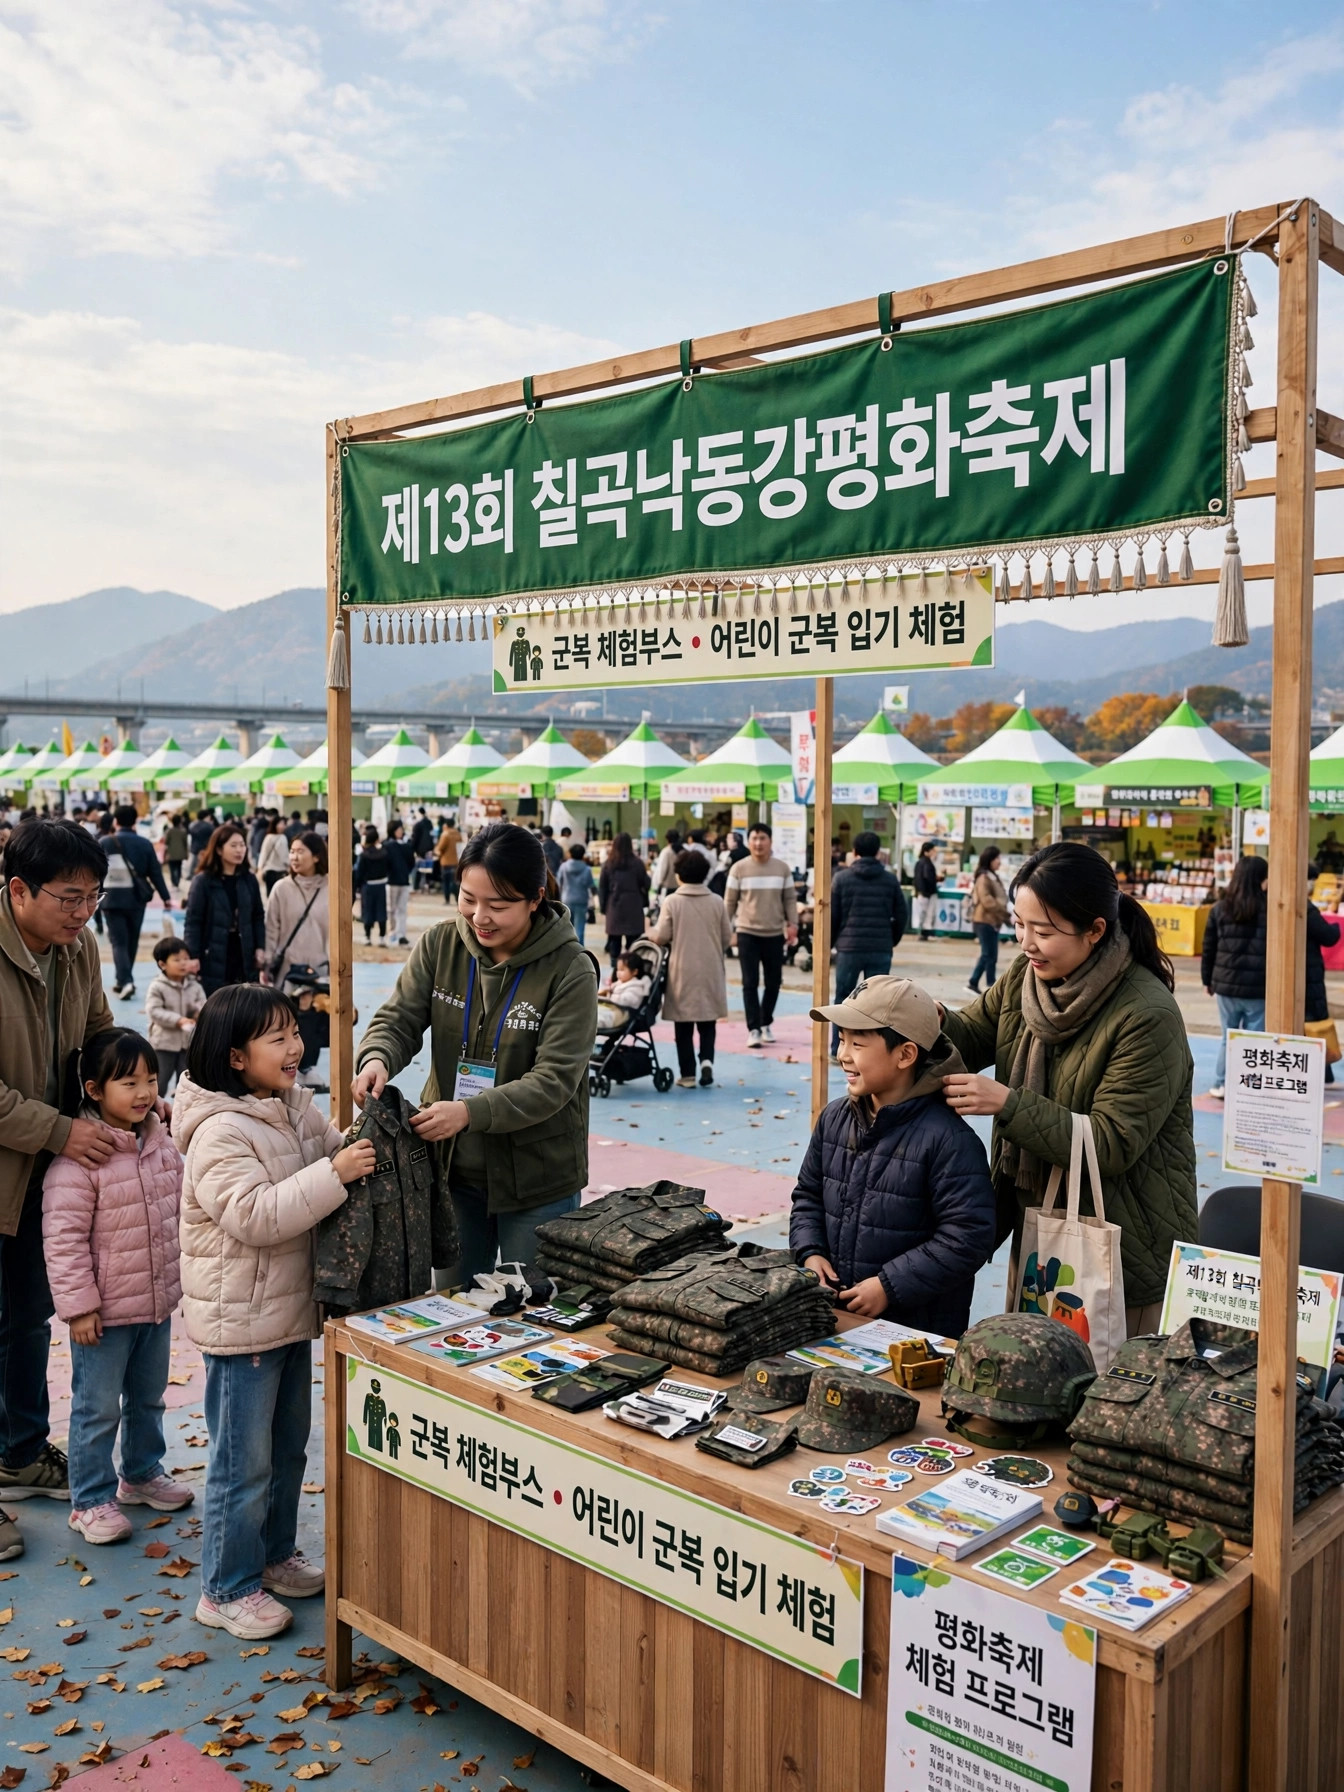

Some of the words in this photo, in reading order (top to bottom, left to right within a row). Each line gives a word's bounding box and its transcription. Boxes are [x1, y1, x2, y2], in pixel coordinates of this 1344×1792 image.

[380, 468, 515, 565] 제13회
[530, 357, 1127, 549] 칠곡낙동강평화축제
[551, 632, 592, 671] 군복
[596, 623, 683, 669] 체험부스
[710, 615, 781, 660] 어린이
[787, 611, 839, 656] 군복
[846, 605, 899, 652] 입기
[908, 600, 966, 647] 체험
[1242, 1048, 1309, 1073] 평화축제
[1263, 1076, 1308, 1095] 프로그램
[410, 1412, 450, 1471] 군복
[456, 1433, 544, 1509] 체험부스
[572, 1484, 644, 1559] 어린이
[652, 1518, 704, 1586] 군복
[712, 1545, 767, 1617] 입기
[776, 1572, 836, 1647] 체험
[934, 1609, 1044, 1687] 평화축제
[905, 1642, 955, 1698] 체험
[963, 1668, 1075, 1749] 프로그램
